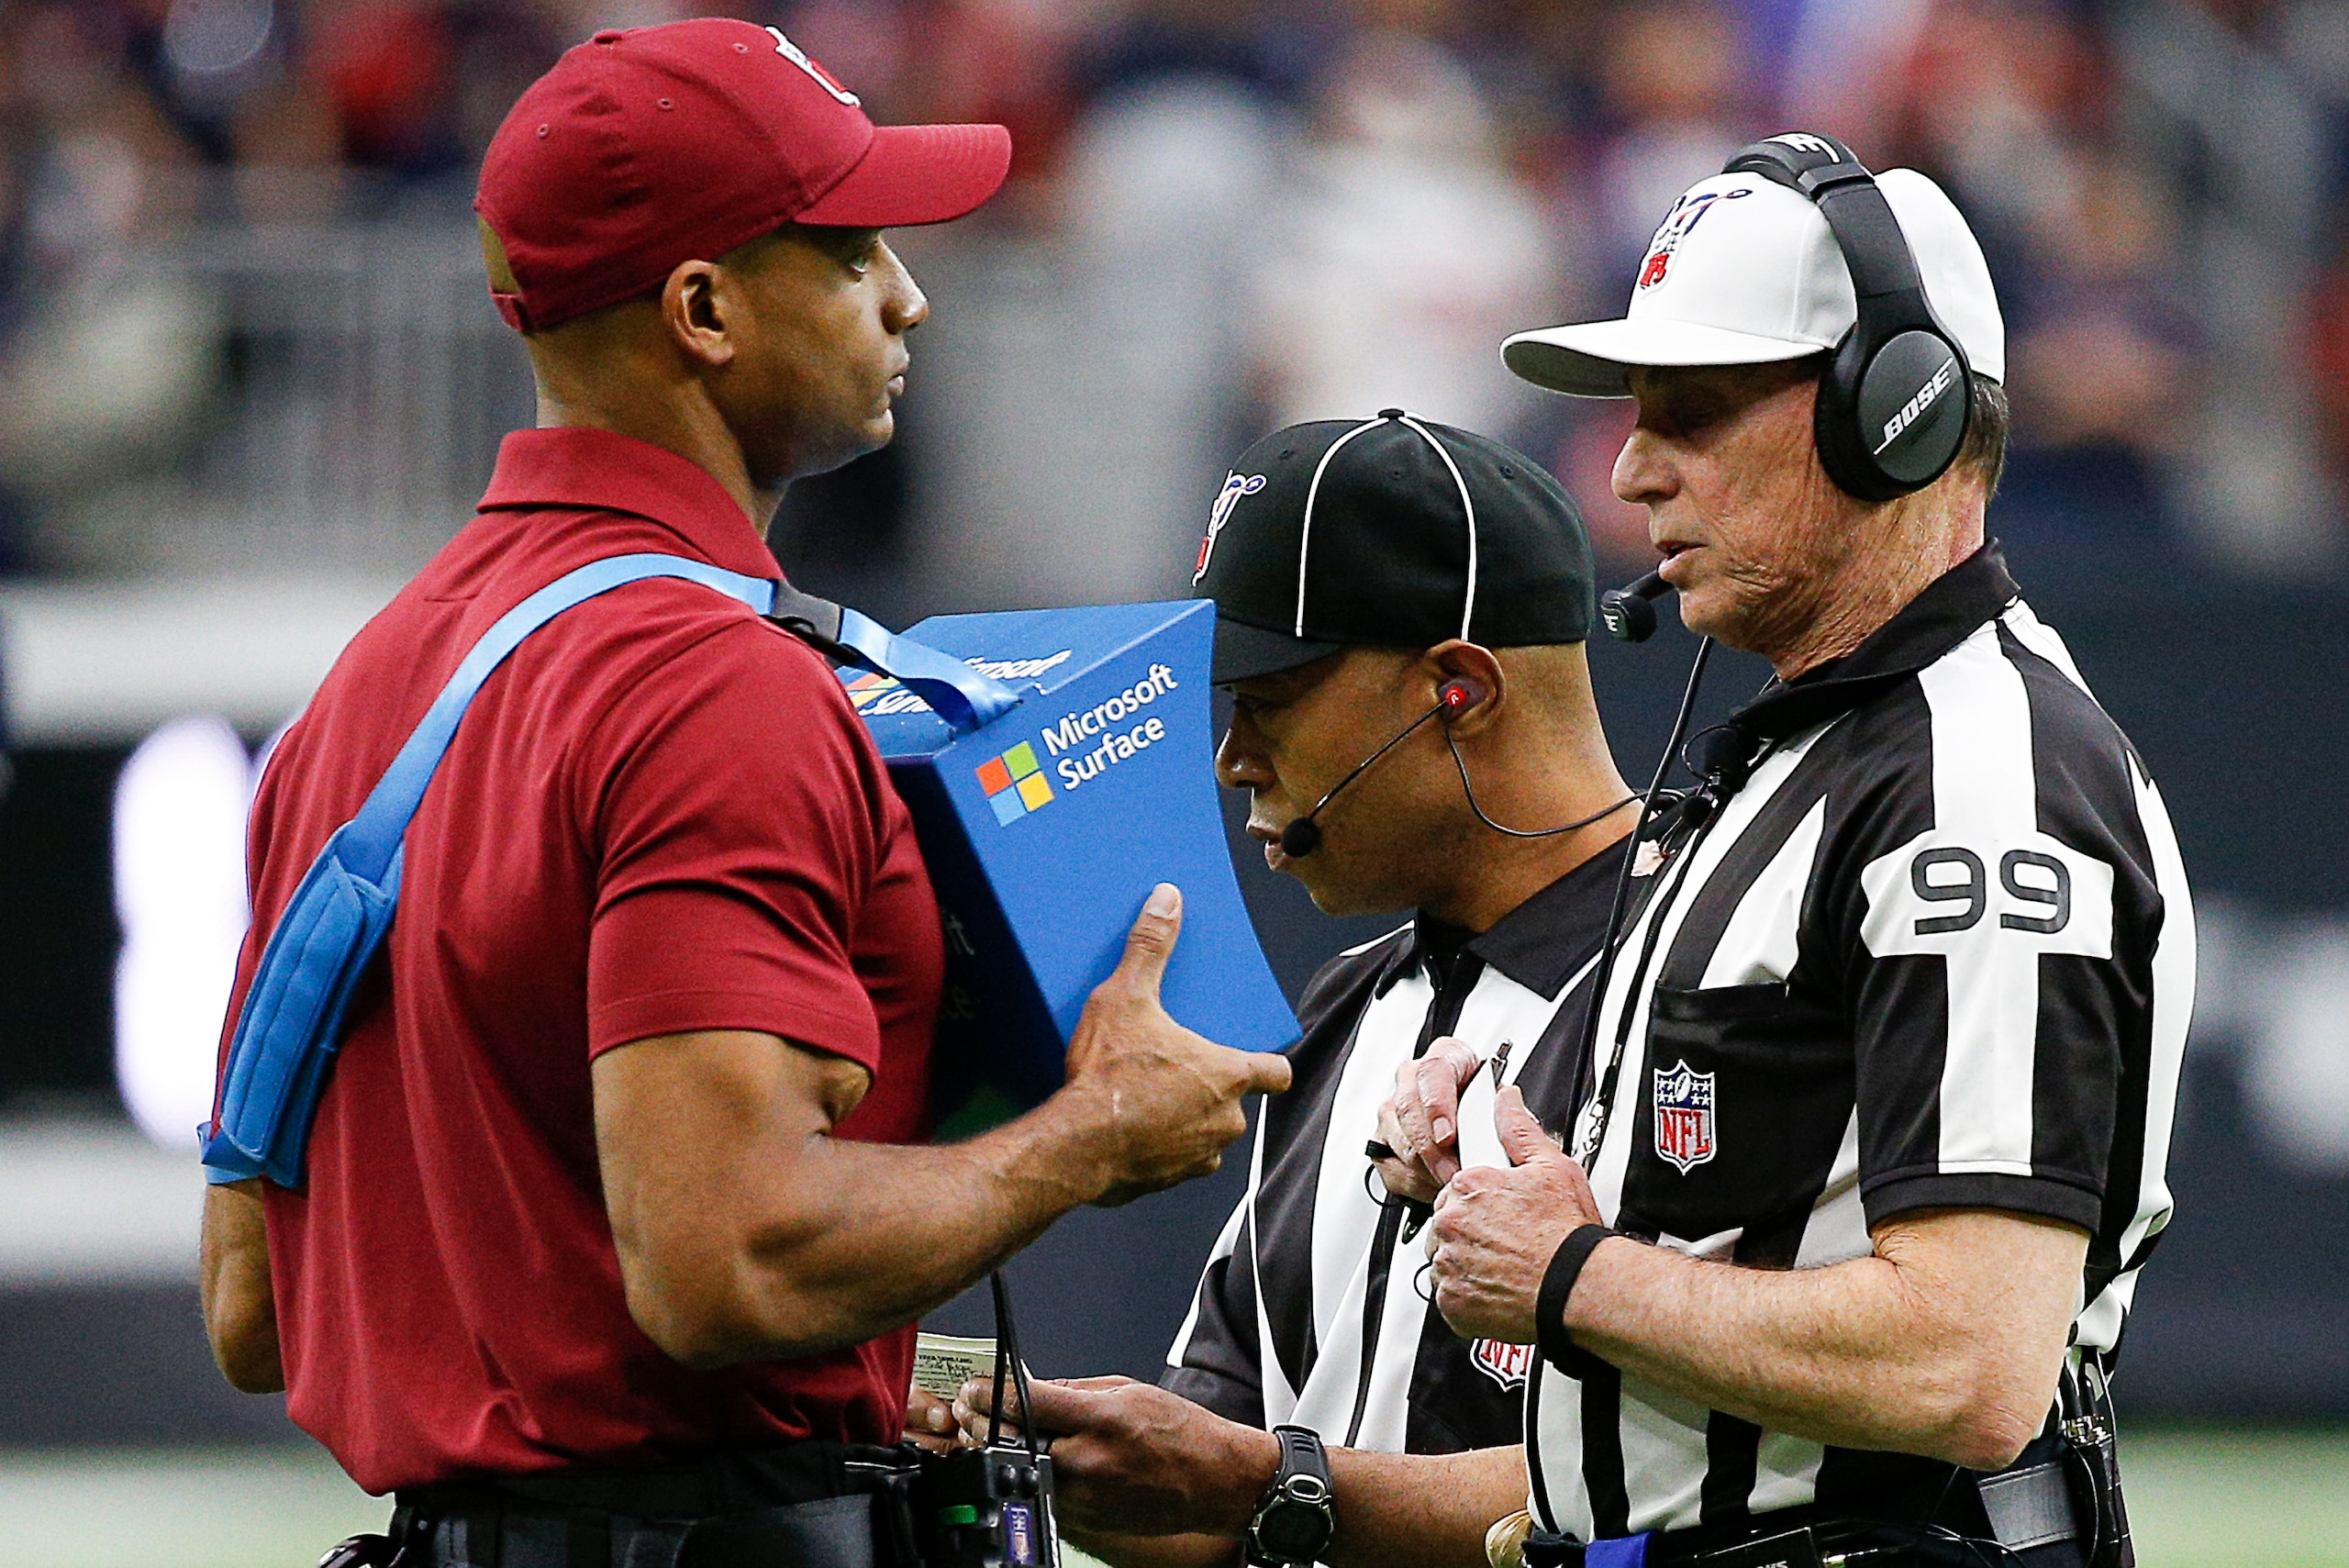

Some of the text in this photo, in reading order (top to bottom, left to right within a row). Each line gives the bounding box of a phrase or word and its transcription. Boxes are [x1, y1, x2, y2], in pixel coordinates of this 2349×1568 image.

[1874, 357, 1954, 455] BOSE
[1041, 663, 1179, 757] Microsoft
[1057, 717, 1166, 791] Surface
[1910, 847, 2071, 936] 99
[1659, 1107, 1711, 1162] NFL
